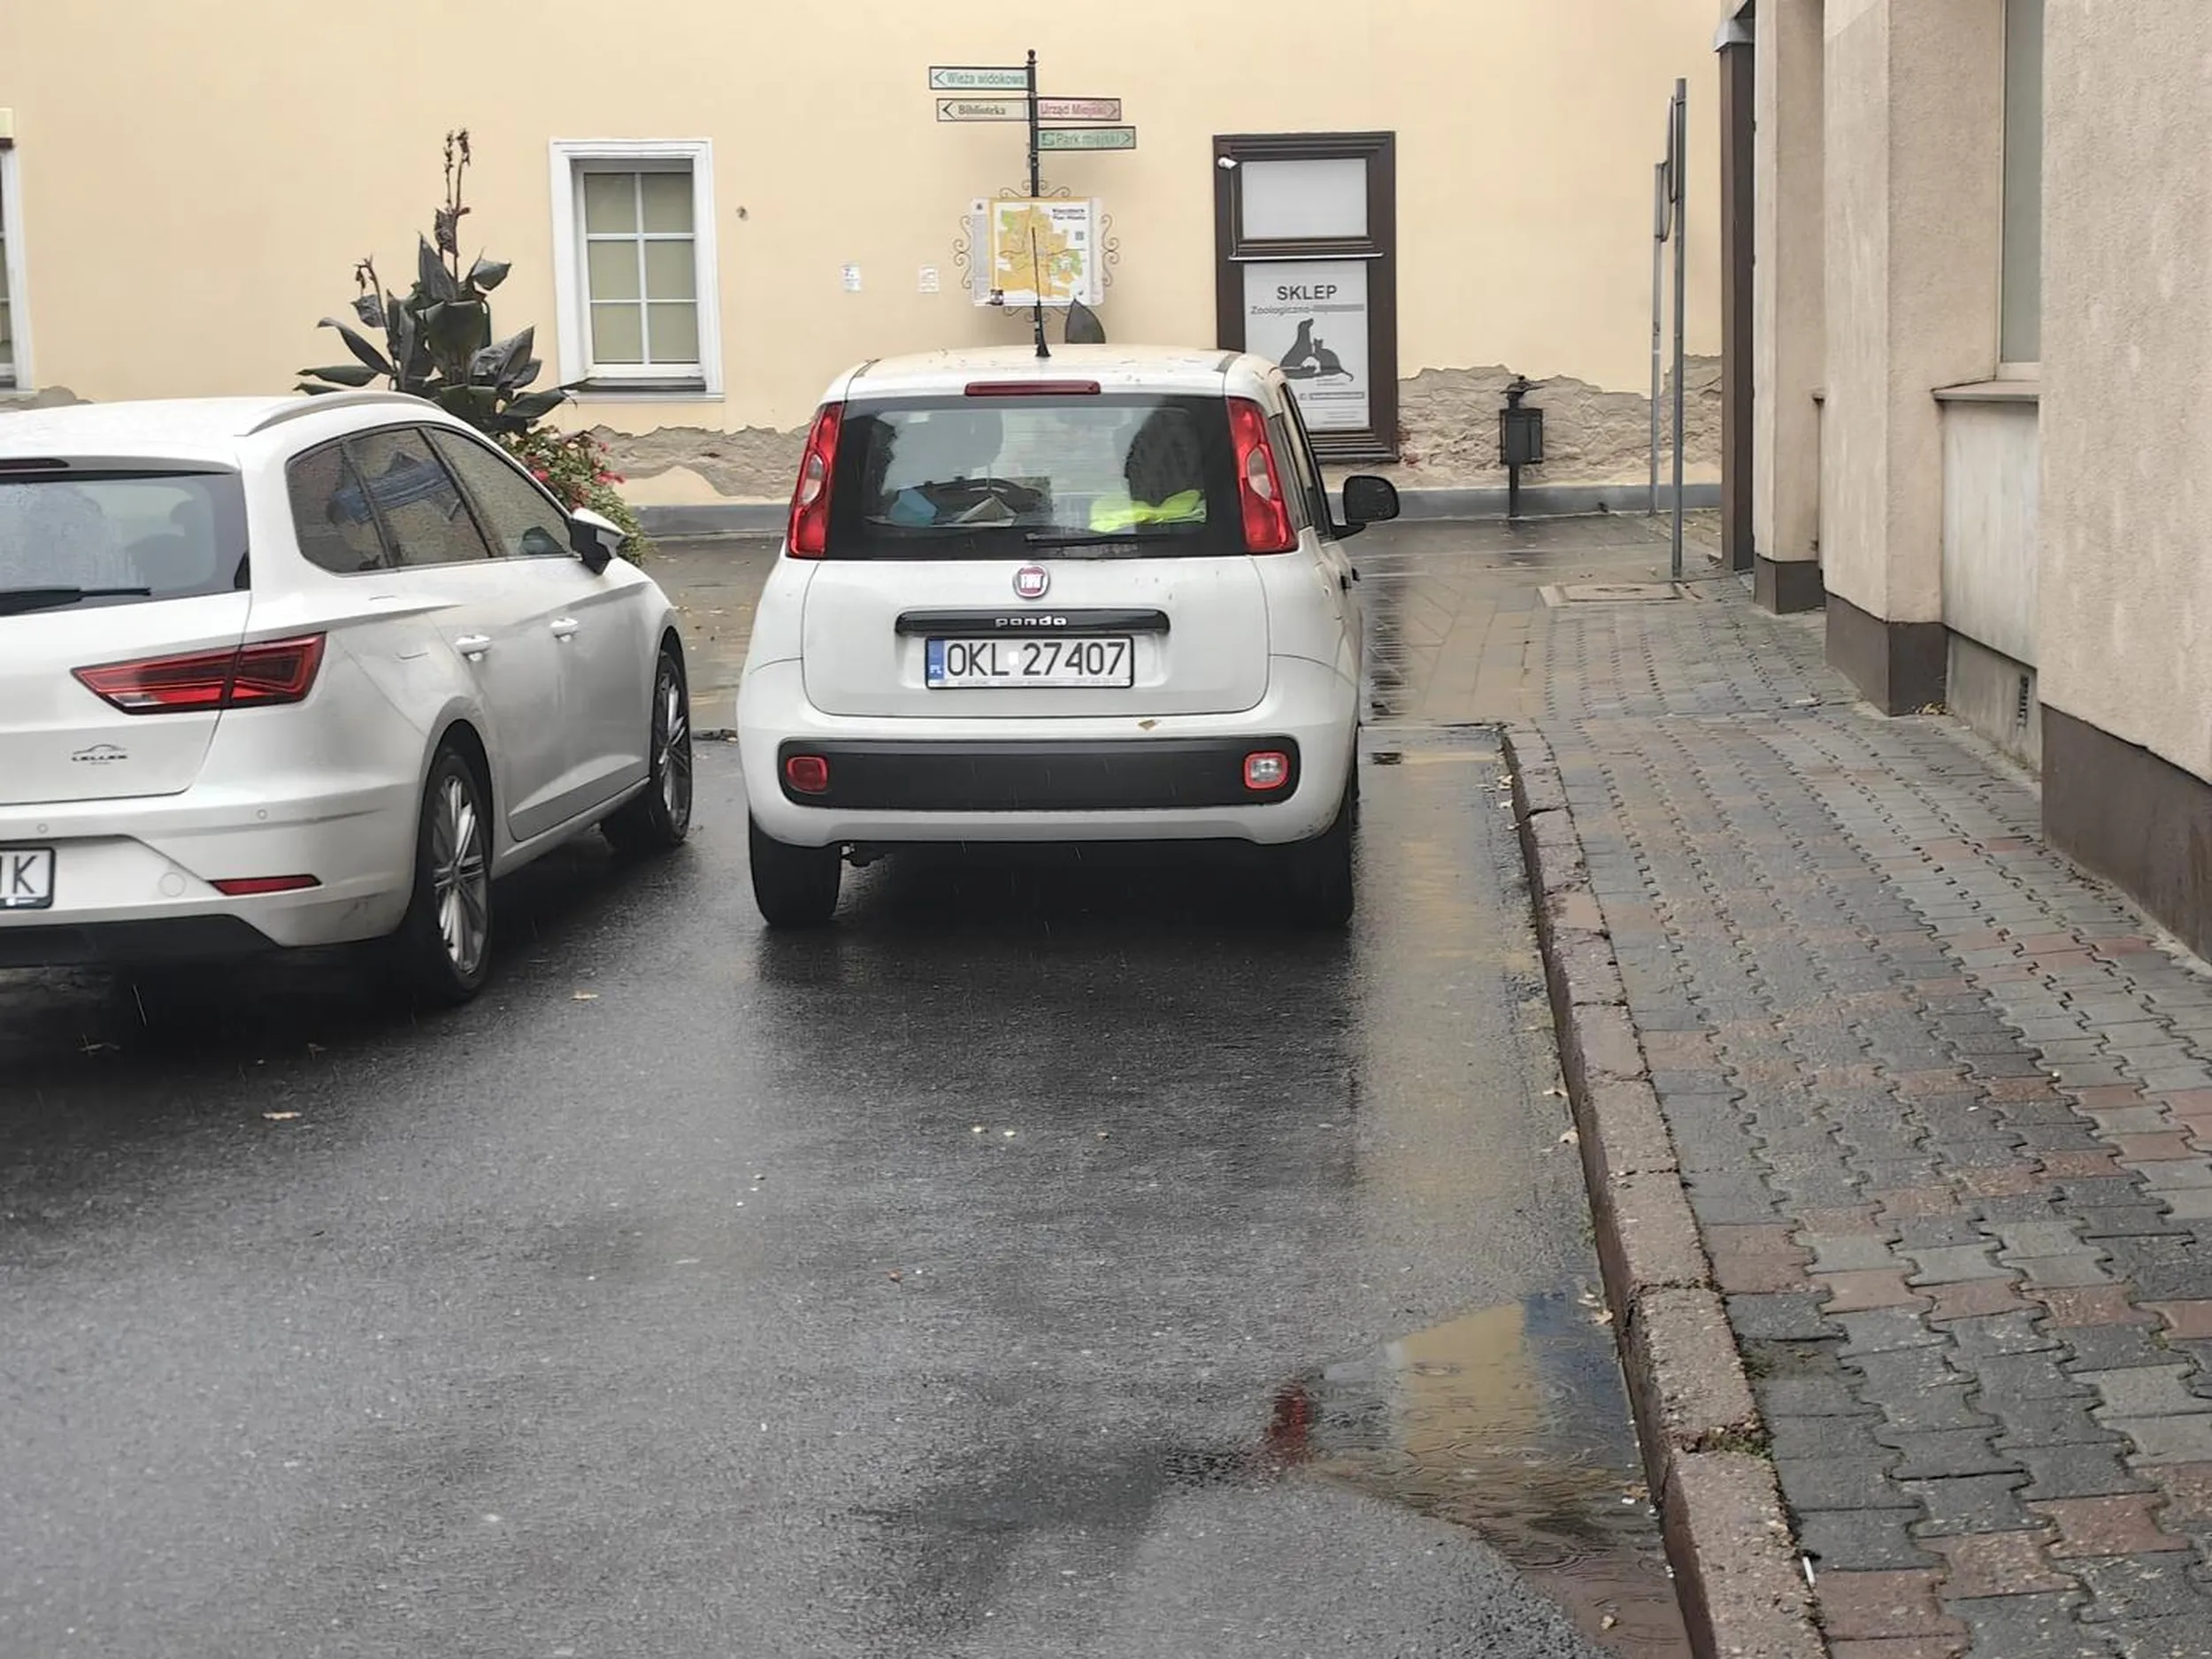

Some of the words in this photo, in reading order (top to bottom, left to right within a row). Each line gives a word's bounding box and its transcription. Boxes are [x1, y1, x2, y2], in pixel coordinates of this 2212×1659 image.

[978, 72, 1025, 85] widokowa
[958, 104, 1006, 115] Biblioteka
[1056, 133, 1079, 144] Park
[1277, 285, 1338, 301] SKLEP
[995, 615, 1067, 627] panda
[947, 642, 1010, 677] OKL
[1022, 641, 1126, 677] 27407
[930, 664, 942, 674] PL
[0, 855, 37, 895] K
